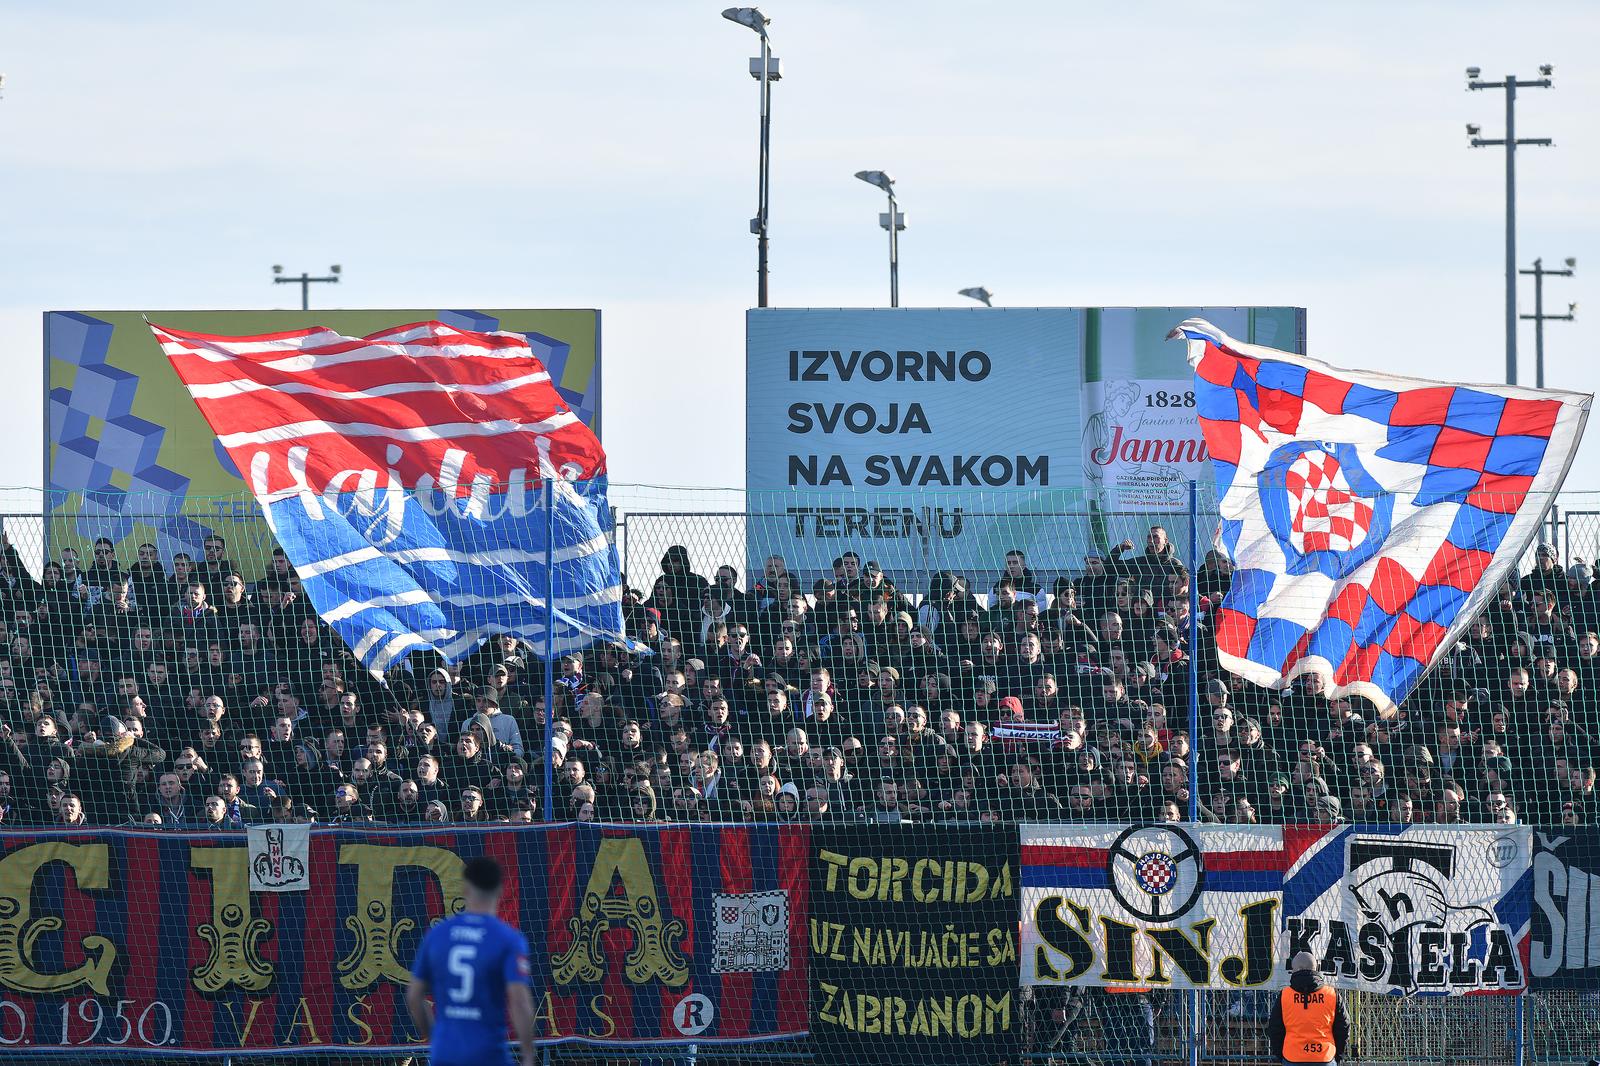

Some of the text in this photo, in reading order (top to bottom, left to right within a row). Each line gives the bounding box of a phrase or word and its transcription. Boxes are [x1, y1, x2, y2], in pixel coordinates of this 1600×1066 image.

[789, 350, 992, 382] IZVORNO
[1145, 390, 1197, 408] 1828
[787, 402, 932, 435] SVOJA
[1129, 410, 1175, 433] Janino
[788, 454, 1050, 487] NA SVAKOM
[787, 507, 963, 539] TERENU
[1138, 853, 1174, 867] HAJDUK
[1491, 845, 1513, 862] VII
[819, 848, 1013, 904] TORCIDA
[1141, 883, 1168, 894] SPLIT
[811, 918, 1016, 968] UZ NAVIJAČE SA
[1034, 896, 1284, 987] SINJ
[447, 944, 478, 1003] 5
[59, 998, 176, 1046] 1950.
[223, 994, 373, 1048] VAŠ
[681, 1000, 703, 1029] R
[819, 981, 1011, 1039] ZABRANOM
[1303, 1043, 1323, 1053] 453
